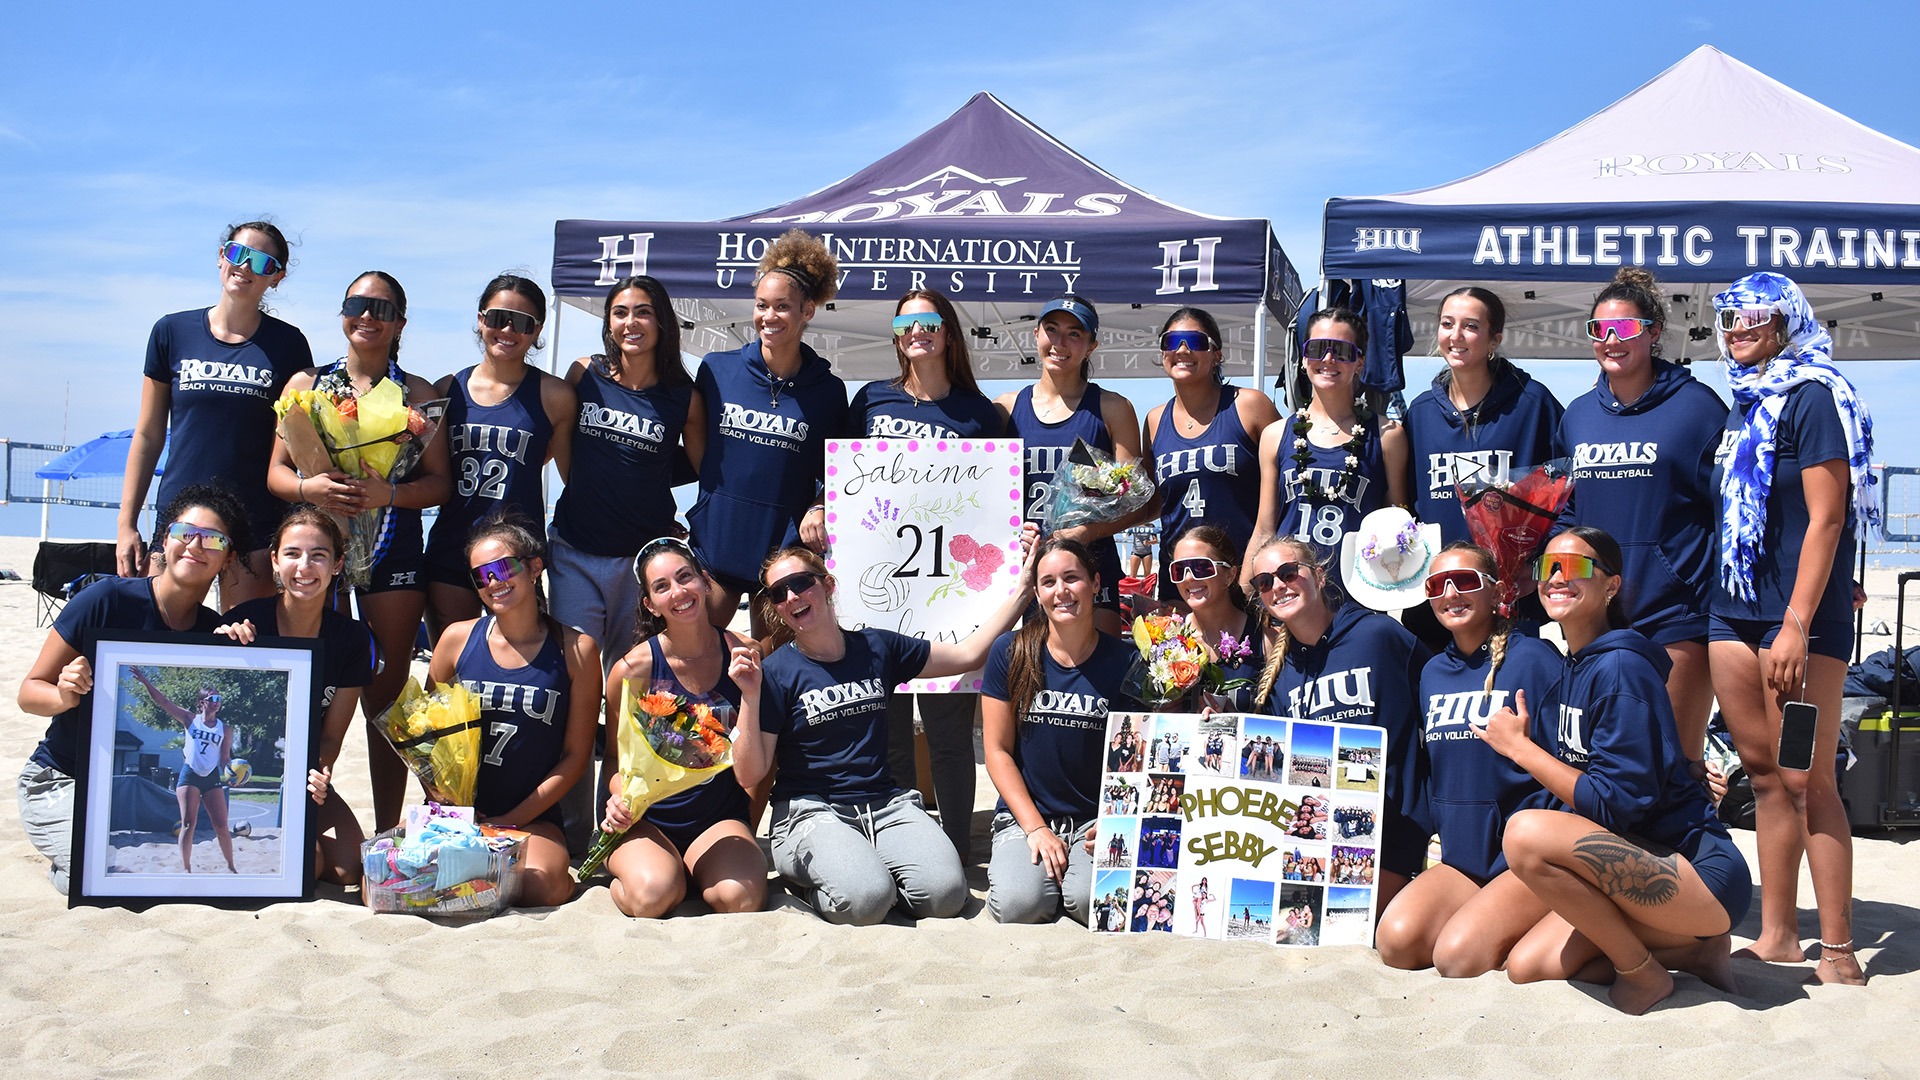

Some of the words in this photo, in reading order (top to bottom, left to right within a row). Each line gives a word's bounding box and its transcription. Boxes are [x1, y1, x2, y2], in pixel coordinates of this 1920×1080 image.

[1593, 151, 1852, 179] ROYALS
[717, 233, 781, 261] HO
[1352, 227, 1422, 254] HIU
[1473, 225, 1714, 267] ATHLETIC
[177, 359, 273, 388] ROYALS
[180, 383, 206, 391] BEACH
[209, 383, 270, 400] VOLLEYBALL
[579, 402, 666, 443] ROYALS
[719, 402, 809, 442] ROYALS
[448, 423, 534, 466] HIU
[604, 432, 659, 453] VOLLEYBALL
[720, 428, 746, 440] BEACH
[748, 434, 801, 453] VOLLEYBALL
[1573, 442, 1658, 471] ROYALS
[458, 457, 509, 500] 32
[844, 452, 994, 496] Sabrina
[1156, 443, 1239, 484] HIU
[1595, 469, 1654, 479] VOLLEYBALL
[1182, 477, 1206, 518] 4
[1430, 491, 1453, 500] BEACH
[1294, 503, 1344, 546] 18
[892, 524, 950, 578] 21
[799, 678, 885, 720] ROYALS
[807, 711, 839, 726] BEACH
[840, 702, 887, 717] VOLLEYBALL
[192, 729, 222, 746] HIU
[1047, 716, 1104, 730] VOLLEYBALL
[200, 741, 209, 755] 7
[483, 721, 518, 766] 7
[1179, 786, 1301, 832] PHOEBE
[1187, 830, 1278, 868] SEBBY
